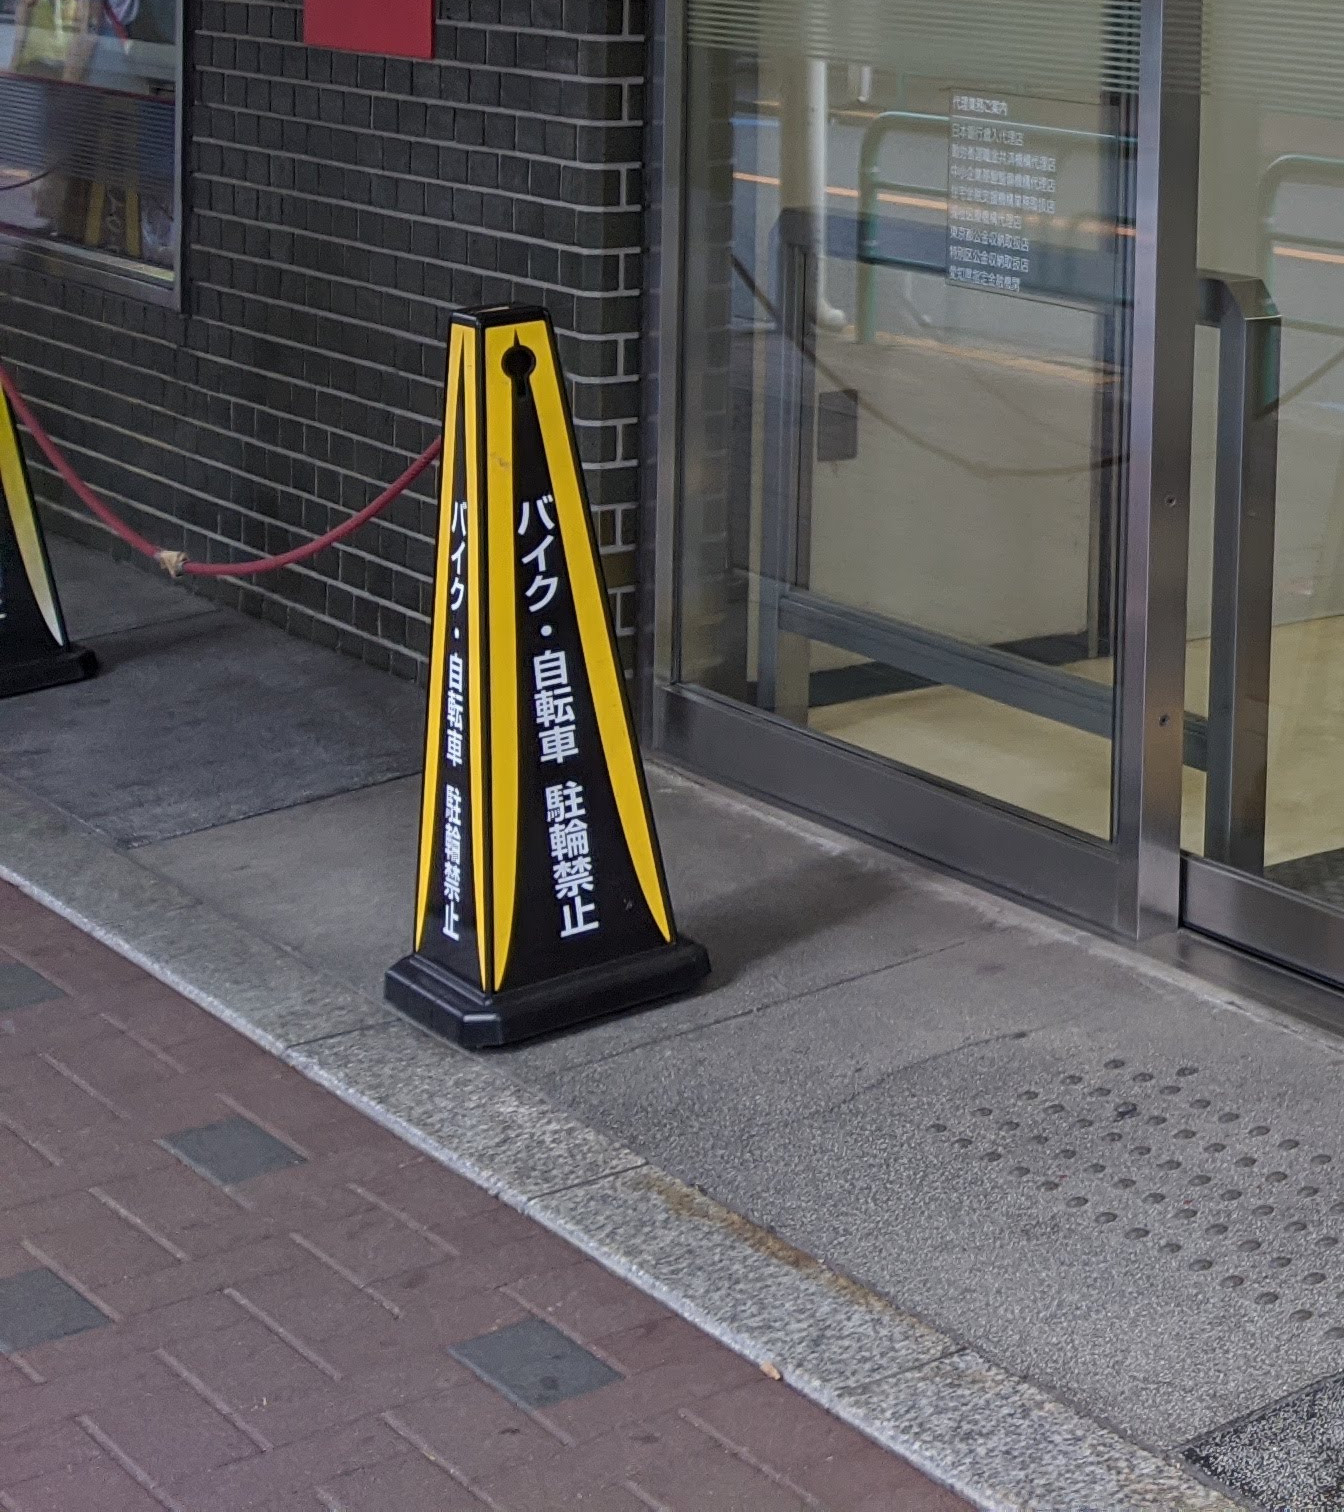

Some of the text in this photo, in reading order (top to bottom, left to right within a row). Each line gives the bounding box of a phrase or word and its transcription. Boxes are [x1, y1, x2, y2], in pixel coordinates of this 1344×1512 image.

[442, 499, 467, 942] バイク・自転車 駐輪禁止
[517, 492, 599, 940] バイク・自転車 駐輪禁止
